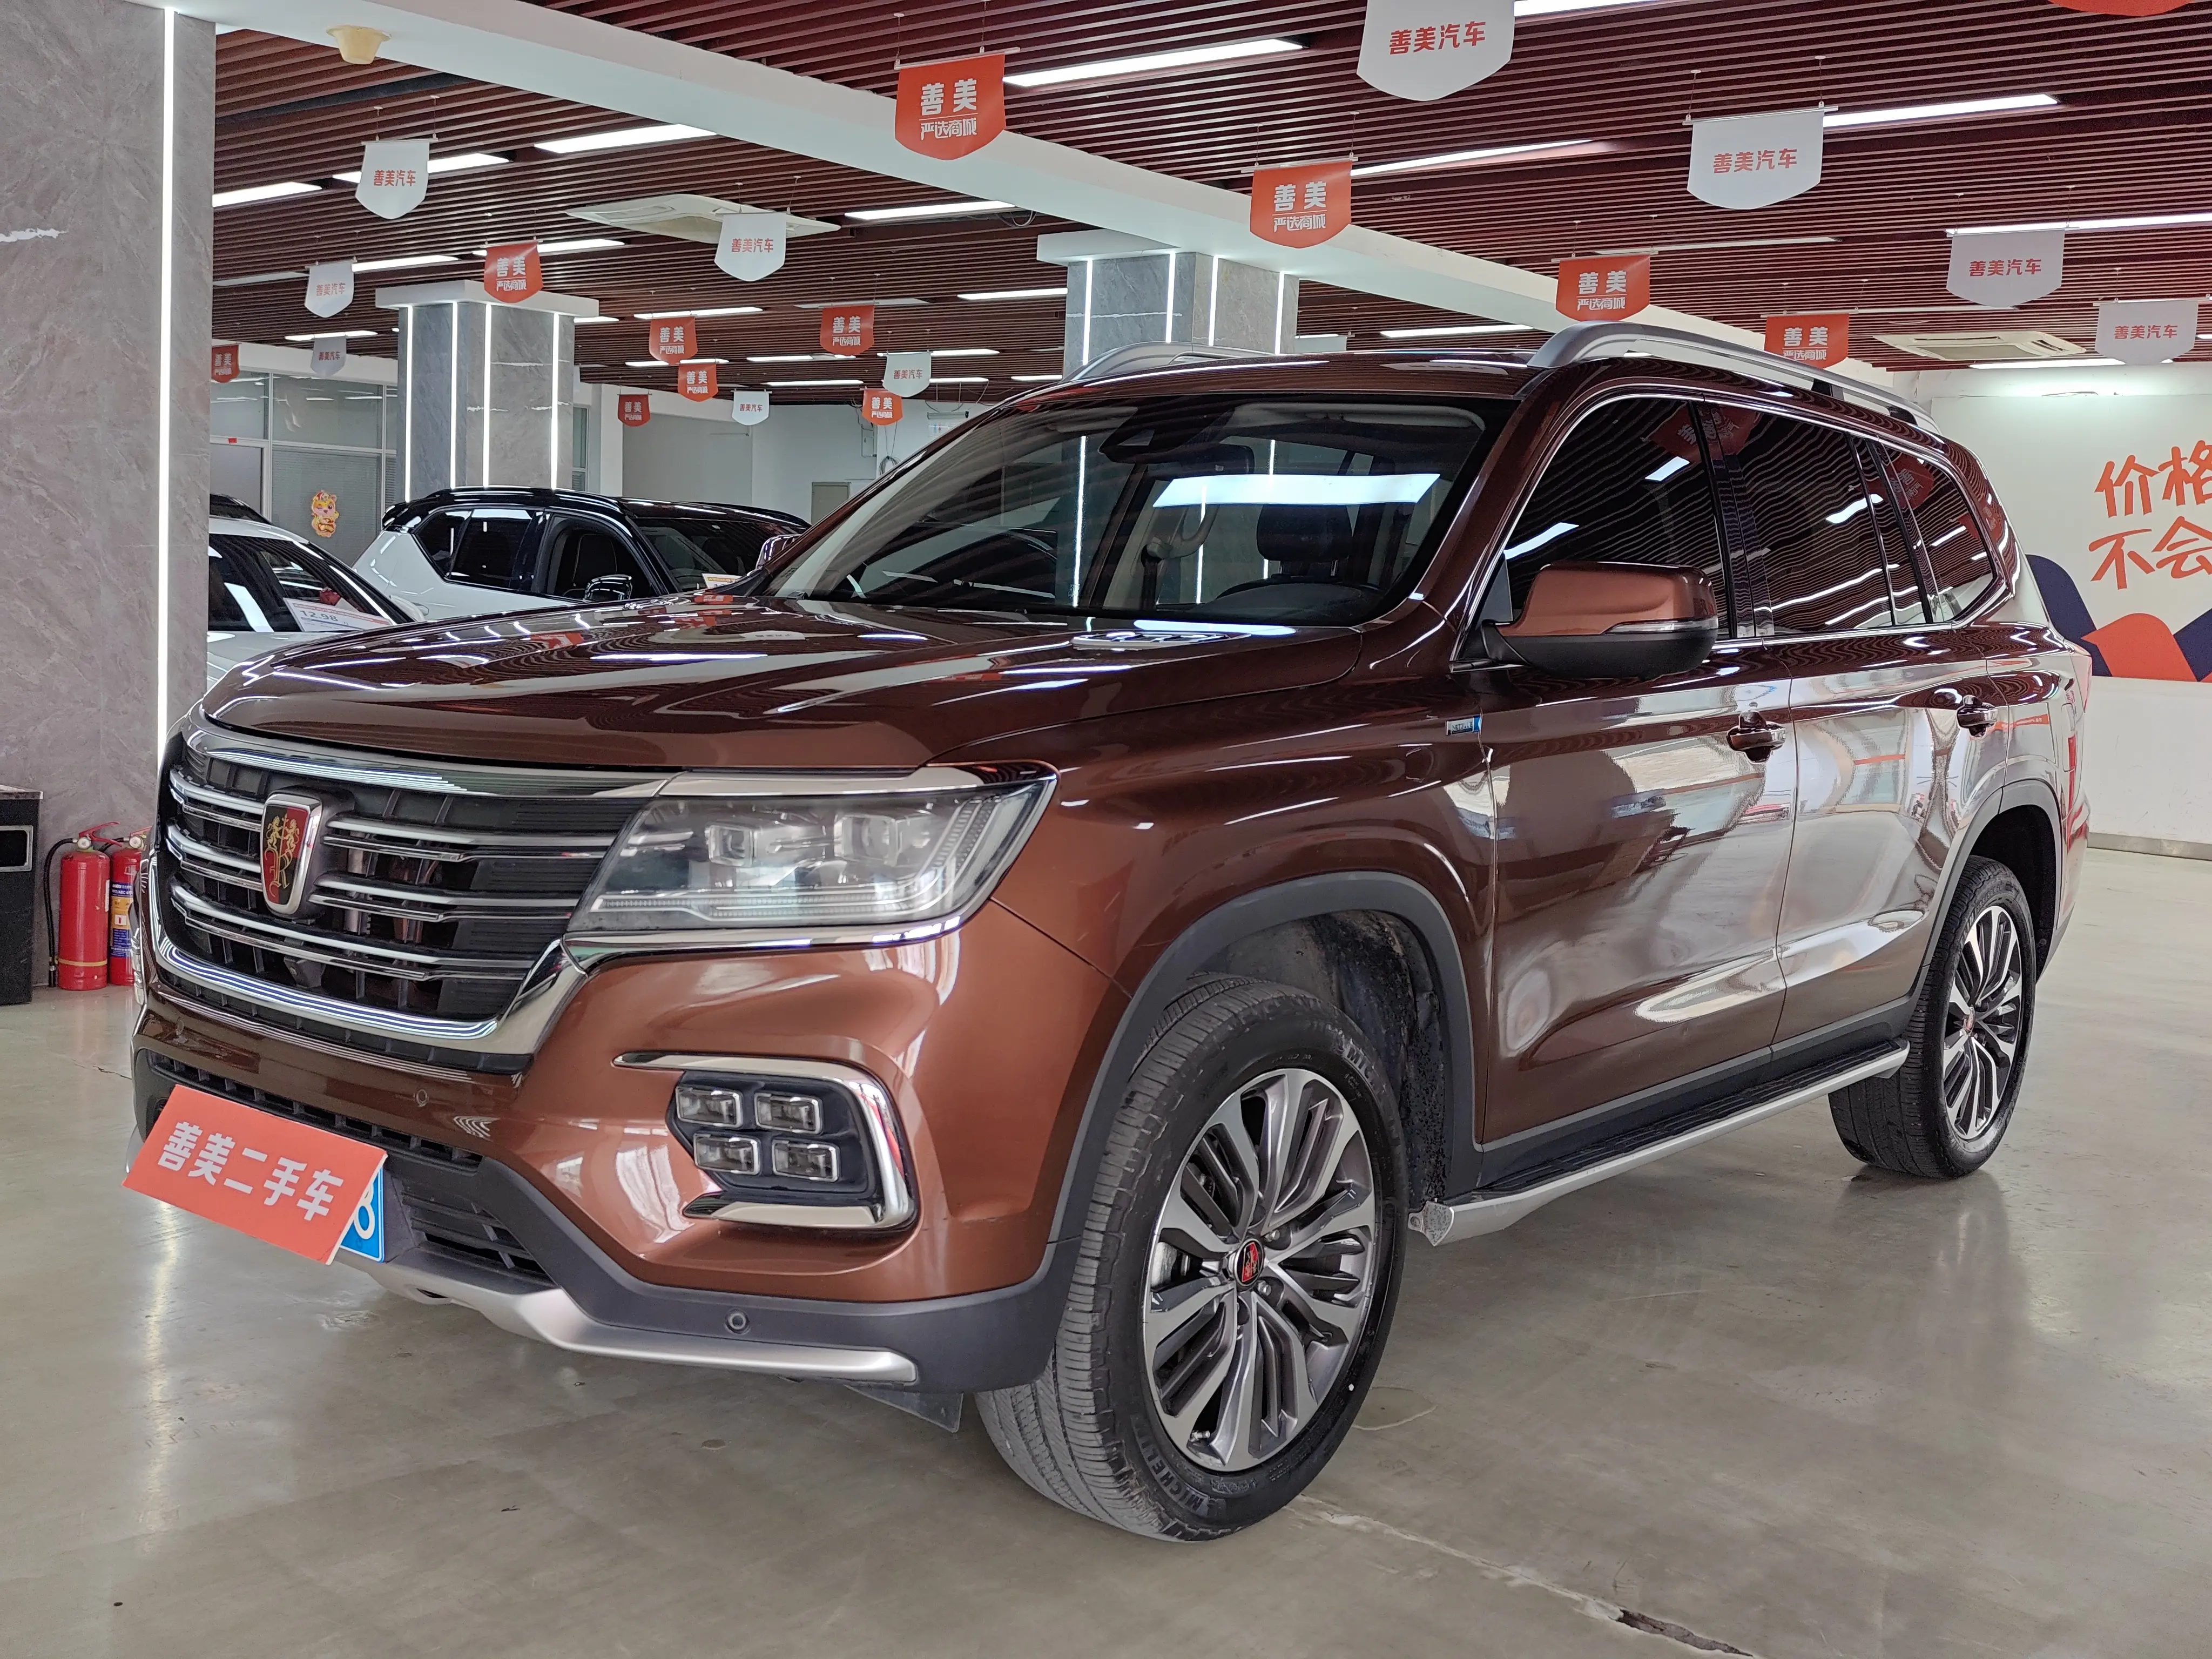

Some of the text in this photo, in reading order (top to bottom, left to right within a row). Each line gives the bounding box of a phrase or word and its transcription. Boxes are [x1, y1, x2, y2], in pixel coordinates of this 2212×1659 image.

[1390, 21, 1486, 55] 善美汽车
[921, 78, 976, 116] 善美
[921, 117, 977, 140] 严选商城
[1713, 148, 1797, 174] 善美汽车
[373, 170, 416, 186] 善美汽车
[1274, 181, 1326, 211] 善美
[1274, 214, 1326, 232] 严选商城
[731, 238, 773, 253] 善美汽车
[497, 257, 525, 276] 善美
[1969, 258, 2041, 276] 善美汽车
[316, 282, 346, 296] 善美汽车
[1579, 271, 1626, 294] 善美
[1577, 297, 1626, 311] 严选商城
[833, 316, 861, 333] 善美
[2114, 325, 2177, 340] 善美汽车
[660, 326, 684, 342] 善美
[1784, 327, 1828, 346] 善美
[1783, 349, 1827, 360] 严选商城
[686, 370, 707, 384] 善美
[894, 369, 922, 379] 善美汽车
[625, 401, 642, 413] 善美
[872, 397, 892, 409] 善美
[2094, 440, 2212, 518] 价格
[2089, 516, 2212, 590] 不会
[300, 610, 338, 622] 12.98
[158, 1122, 343, 1221] 善美二手车
